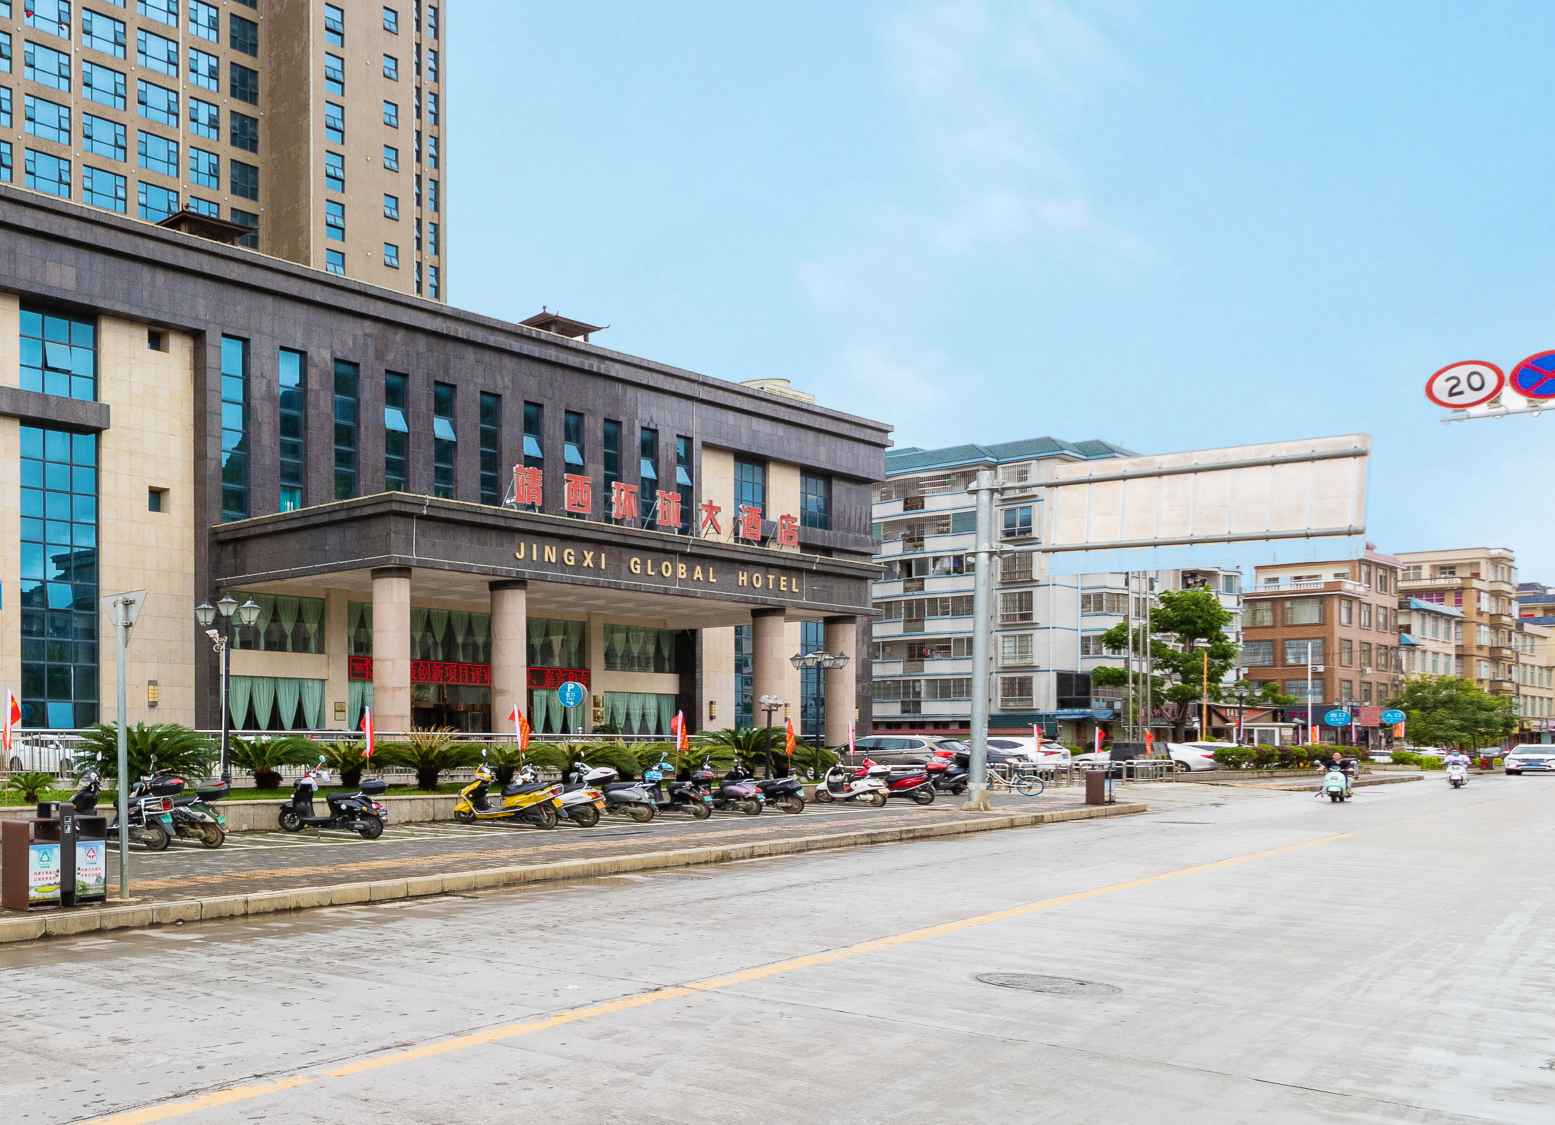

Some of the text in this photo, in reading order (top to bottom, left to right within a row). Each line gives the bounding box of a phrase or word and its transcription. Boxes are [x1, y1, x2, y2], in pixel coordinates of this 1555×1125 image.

[1444, 371, 1486, 397] 20
[513, 464, 800, 547] 靖西环球大酒店
[515, 542, 800, 593] JINGXI GLOBAL HOTEL
[567, 683, 575, 693] P
